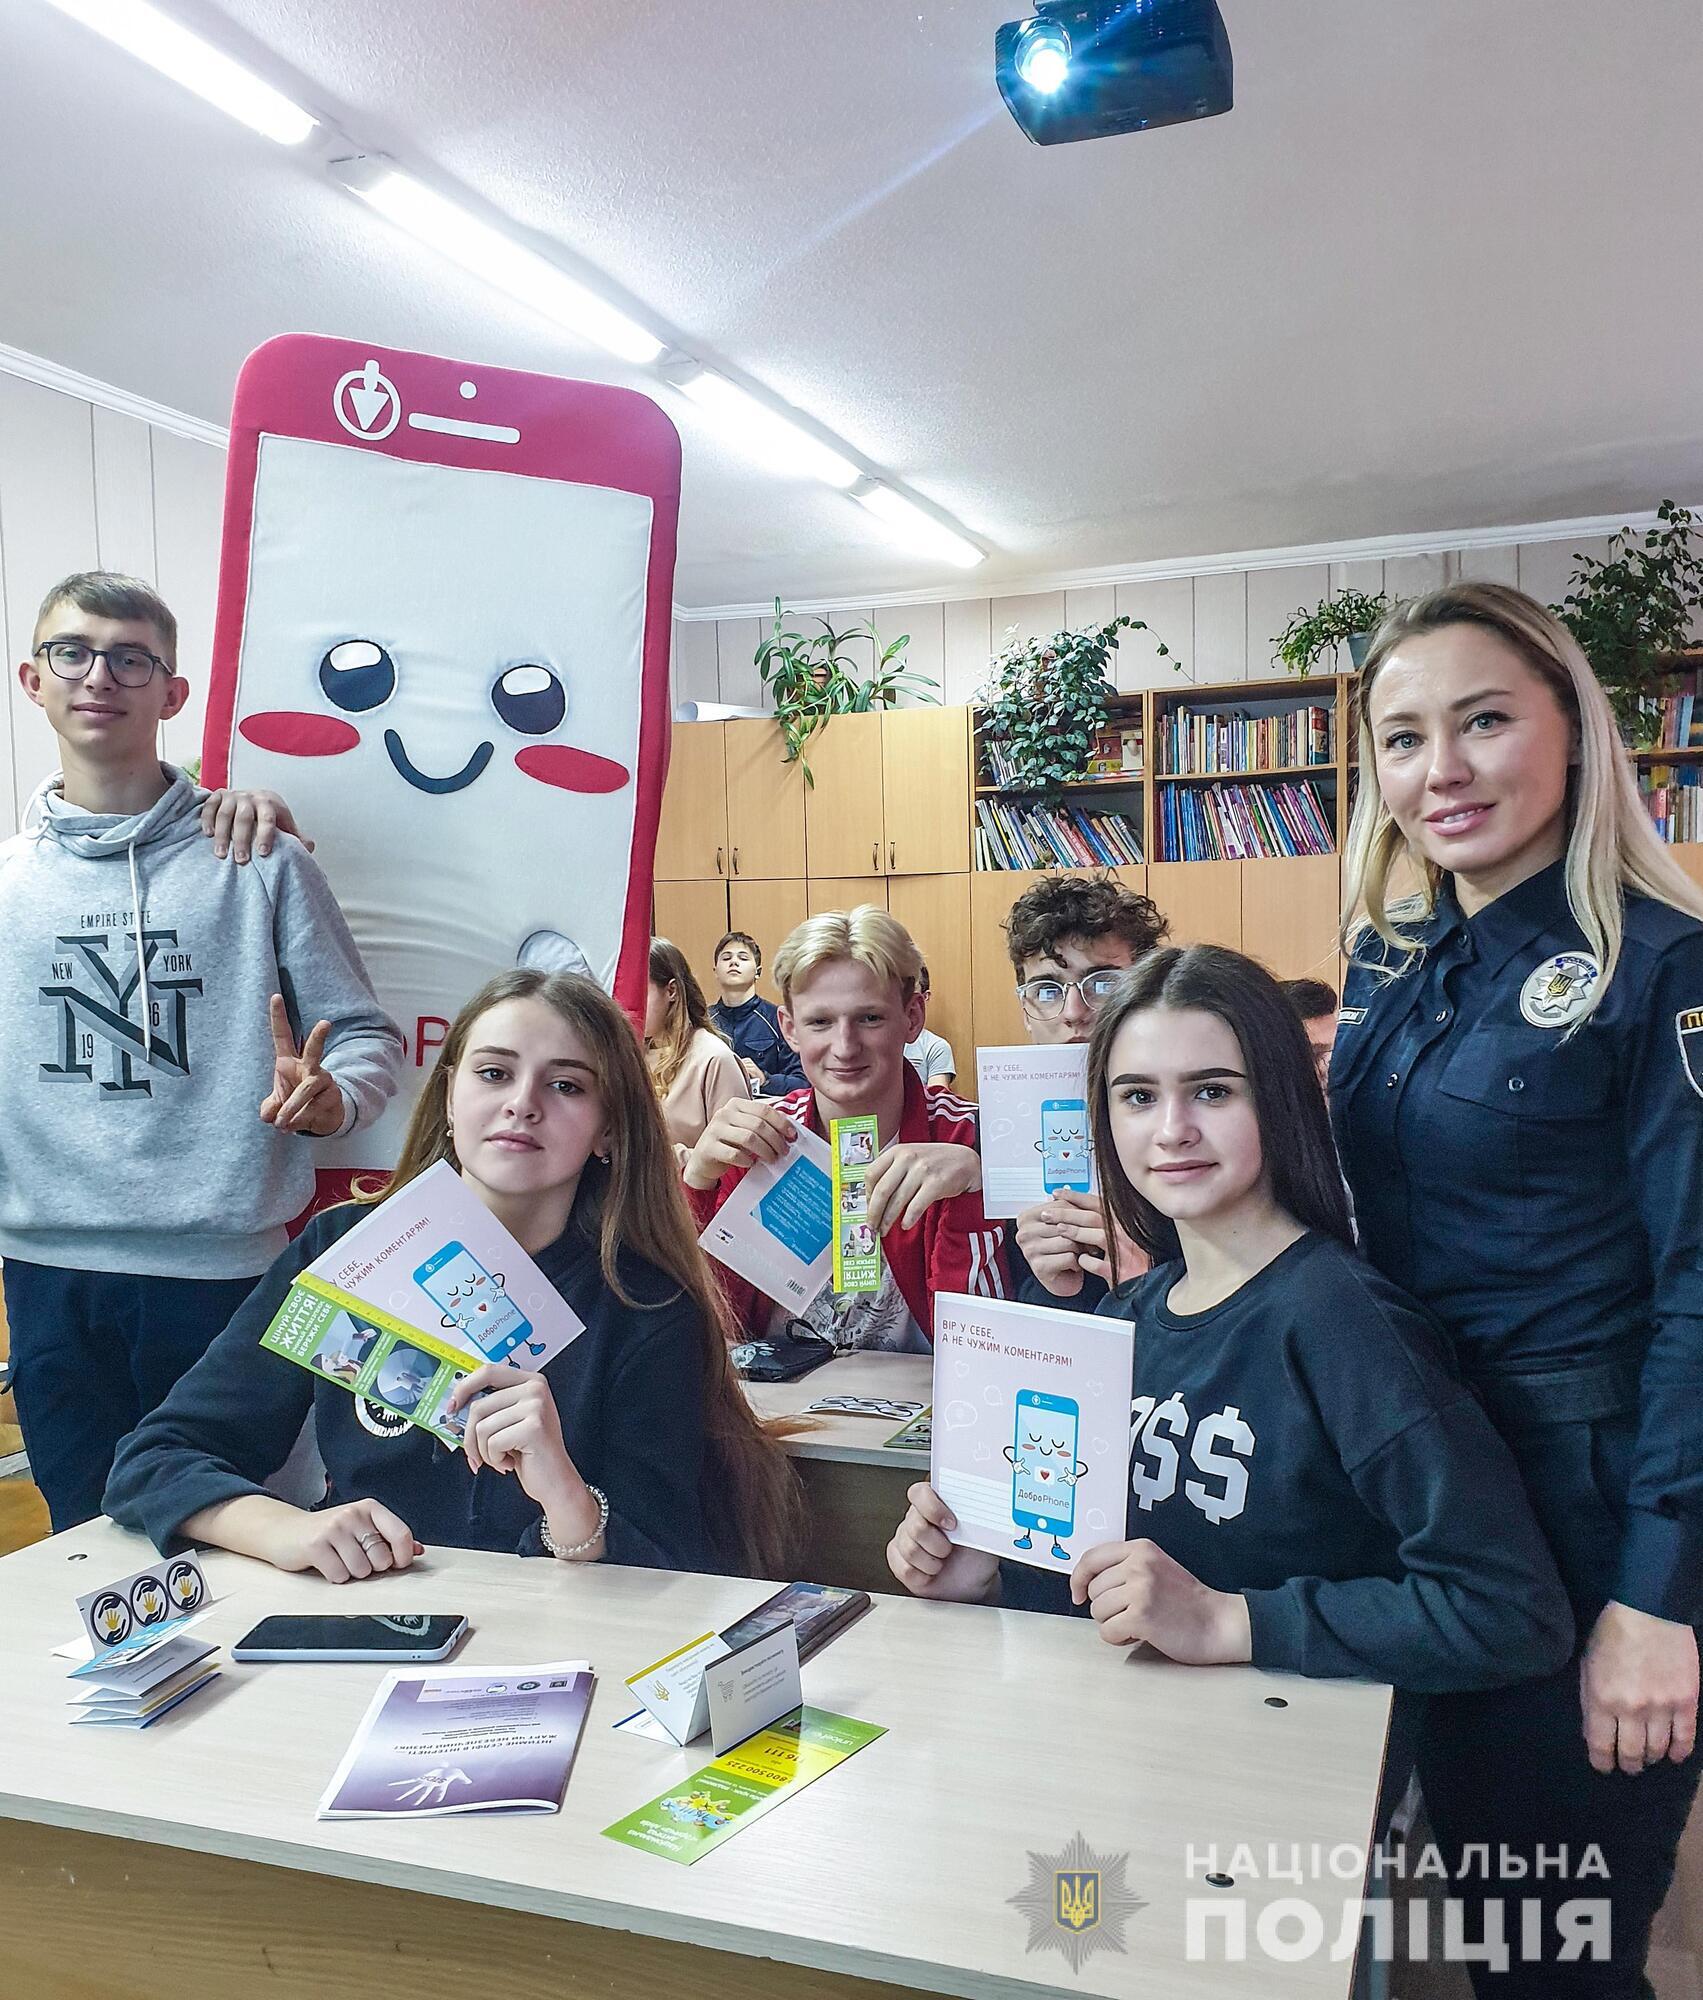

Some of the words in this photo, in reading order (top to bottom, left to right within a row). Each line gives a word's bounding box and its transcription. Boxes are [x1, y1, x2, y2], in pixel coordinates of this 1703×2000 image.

[81, 912, 117, 928] EMPIRE
[122, 911, 151, 926] STTE
[52, 962, 73, 980] NEW
[163, 954, 193, 972] YORK
[82, 1033, 94, 1059] 19
[990, 1073, 1000, 1081] НЕ
[1002, 1073, 1029, 1081] ЧУЖИМ
[996, 1064, 1001, 1072] У
[344, 1262, 376, 1290] ЧУЖИМ
[374, 1216, 432, 1265] КОМЕНТАРЯМ!
[843, 1270, 876, 1280] ЖИТТЯ!
[270, 1313, 292, 1344] ЦІНУЙ
[279, 1293, 319, 1350] ЖИТТЯ!
[297, 1323, 321, 1357] БЕРЕЖИ
[317, 1302, 333, 1323] СЕБЕ
[942, 1319, 957, 1331] ВІР
[960, 1323, 966, 1333] У
[942, 1333, 949, 1343] А
[952, 1335, 963, 1346] НЕ
[967, 1337, 1001, 1353] ЧУЖИМ
[1003, 1345, 1073, 1367] КОМЕНТАРЯМ!
